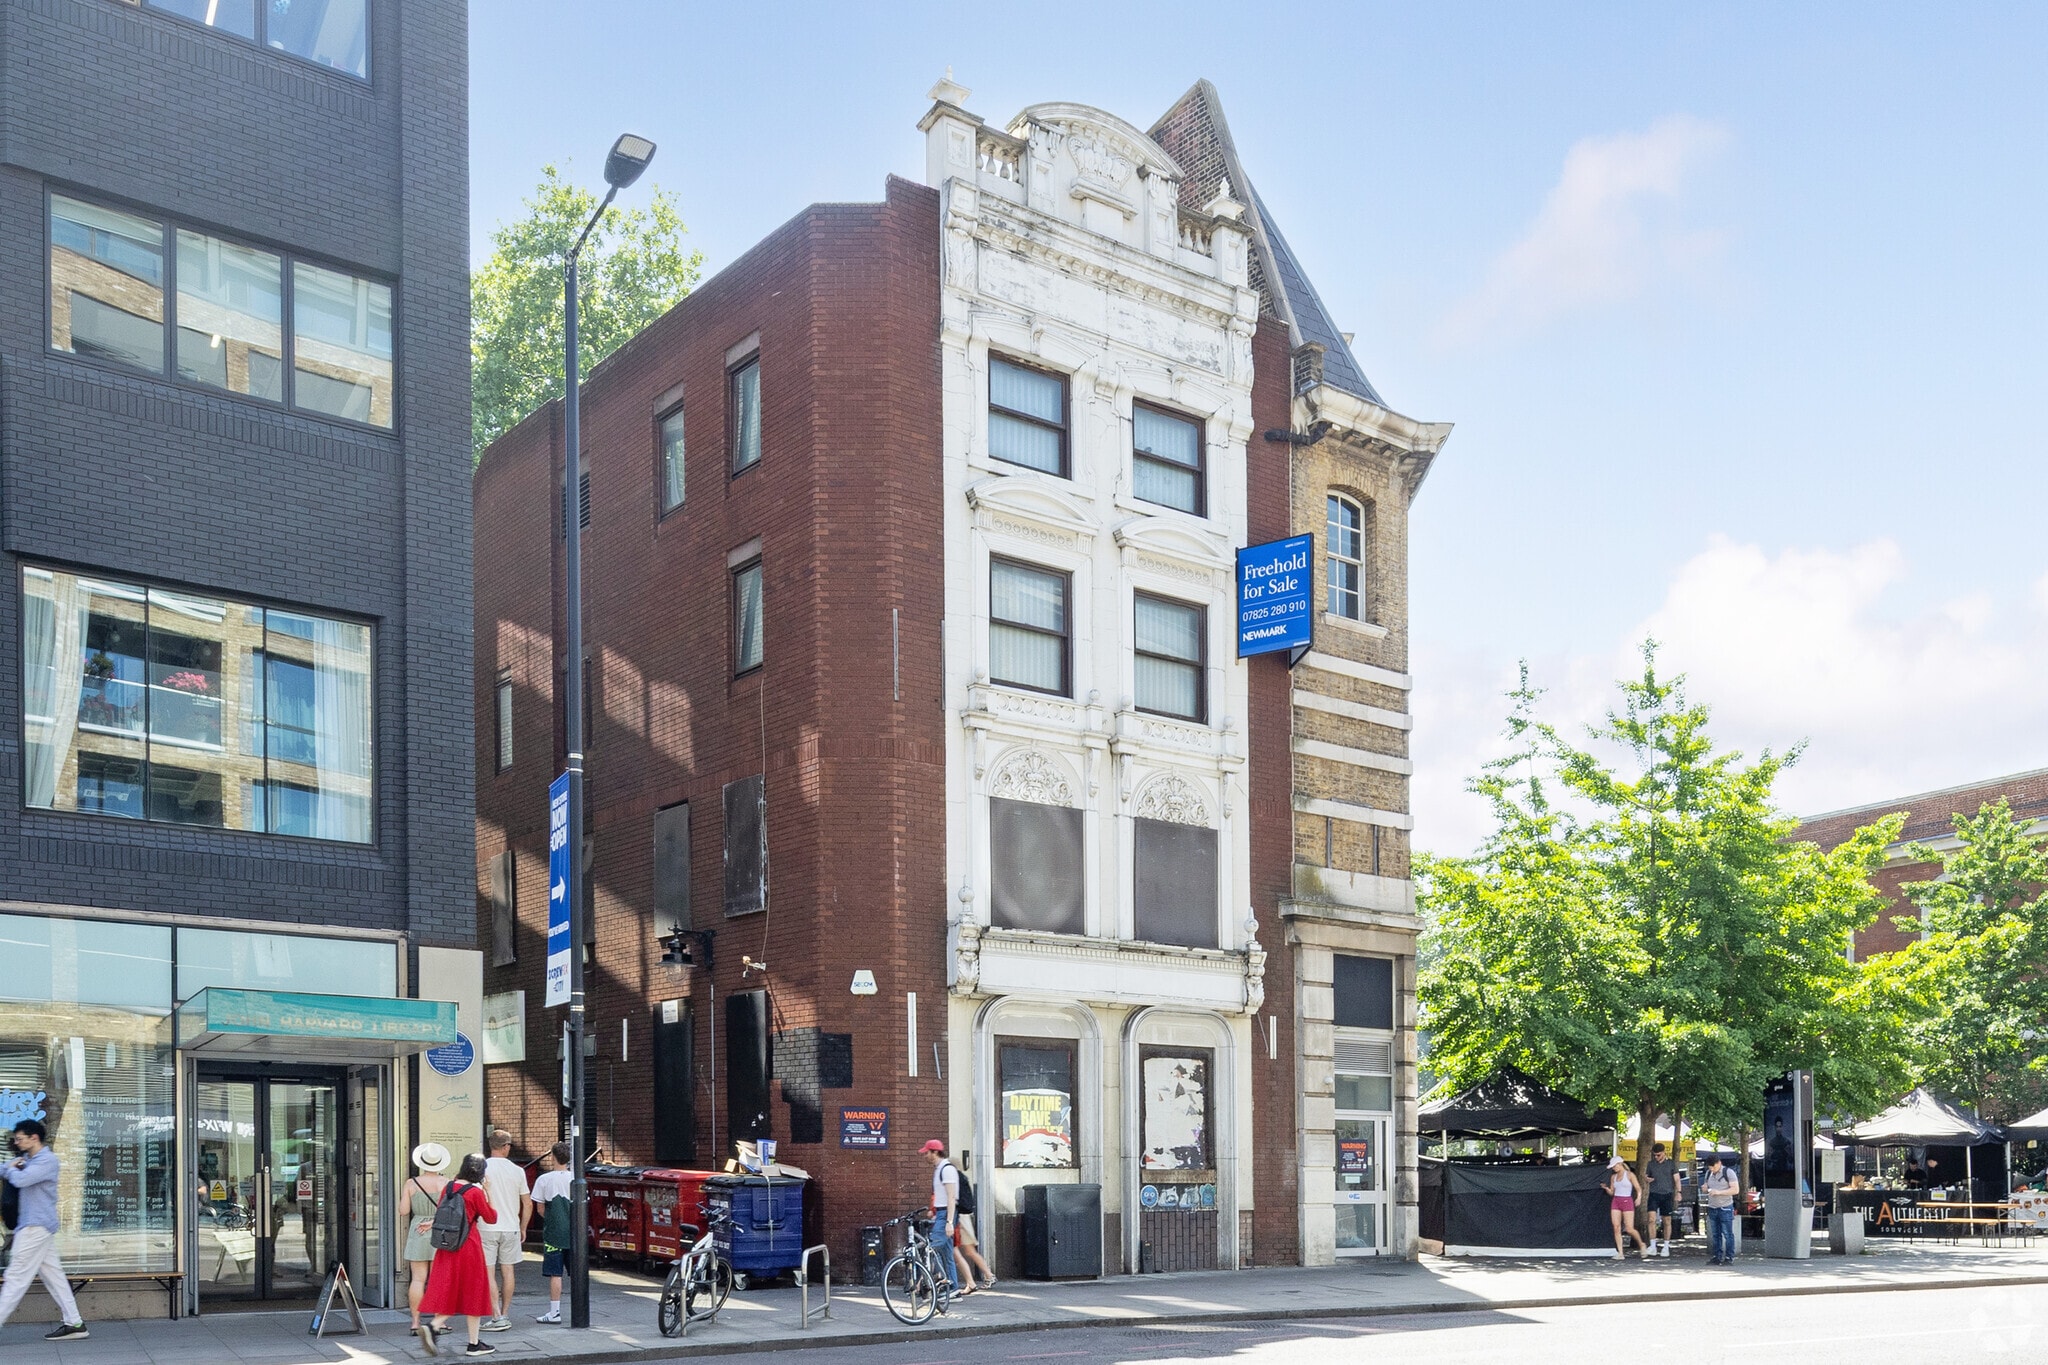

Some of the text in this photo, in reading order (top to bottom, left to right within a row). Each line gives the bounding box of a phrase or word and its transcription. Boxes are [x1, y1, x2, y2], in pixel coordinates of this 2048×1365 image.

[1244, 551, 1306, 580] Freehold
[1244, 575, 1298, 600] for Sale
[1242, 599, 1306, 622] 07825 280 910
[1242, 624, 1288, 642] NEWMARK
[552, 801, 568, 833] NOW
[551, 824, 567, 852] OPEN
[548, 963, 569, 980] SCREWFIX
[280, 1016, 363, 1031] HARVARD
[1010, 1095, 1062, 1111] DAYTIME
[96, 1110, 135, 1119] Harvard
[844, 1111, 886, 1119] WARNING
[1020, 1110, 1051, 1126] RAVE
[1009, 1125, 1064, 1140] HAEY
[1853, 1206, 1875, 1222] THE
